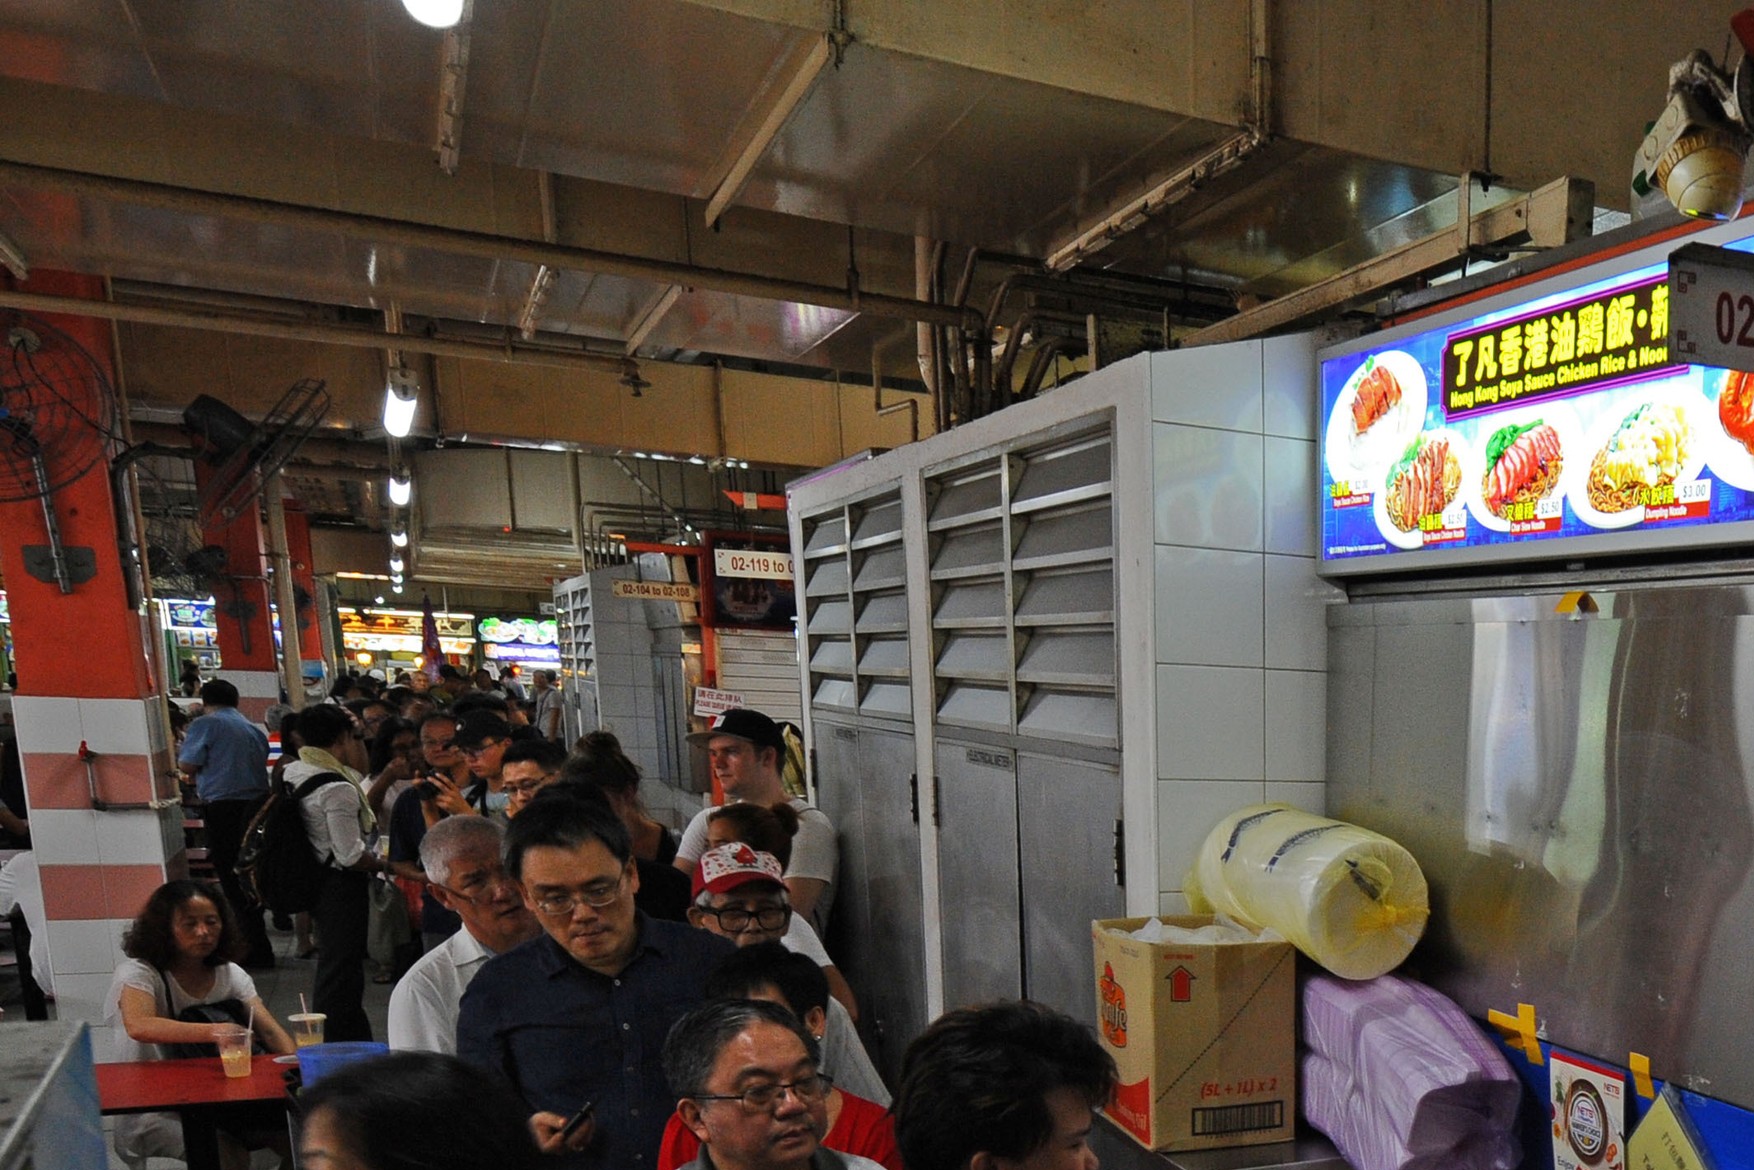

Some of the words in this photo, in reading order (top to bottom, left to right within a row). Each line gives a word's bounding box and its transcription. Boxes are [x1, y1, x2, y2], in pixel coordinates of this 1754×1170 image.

[1451, 389, 1473, 408] Hong
[1475, 383, 1498, 403] Kong
[1500, 379, 1523, 398] Soya
[1524, 373, 1555, 391] Sauce
[1557, 363, 1598, 385] Chicken
[1600, 354, 1625, 375] Rice
[1627, 350, 1637, 368] &
[1683, 484, 1706, 498] $3.00
[731, 556, 769, 572] 02-119
[773, 559, 784, 573] to
[622, 584, 650, 594] 02-104
[652, 586, 661, 595] to
[662, 586, 690, 597] 02-108
